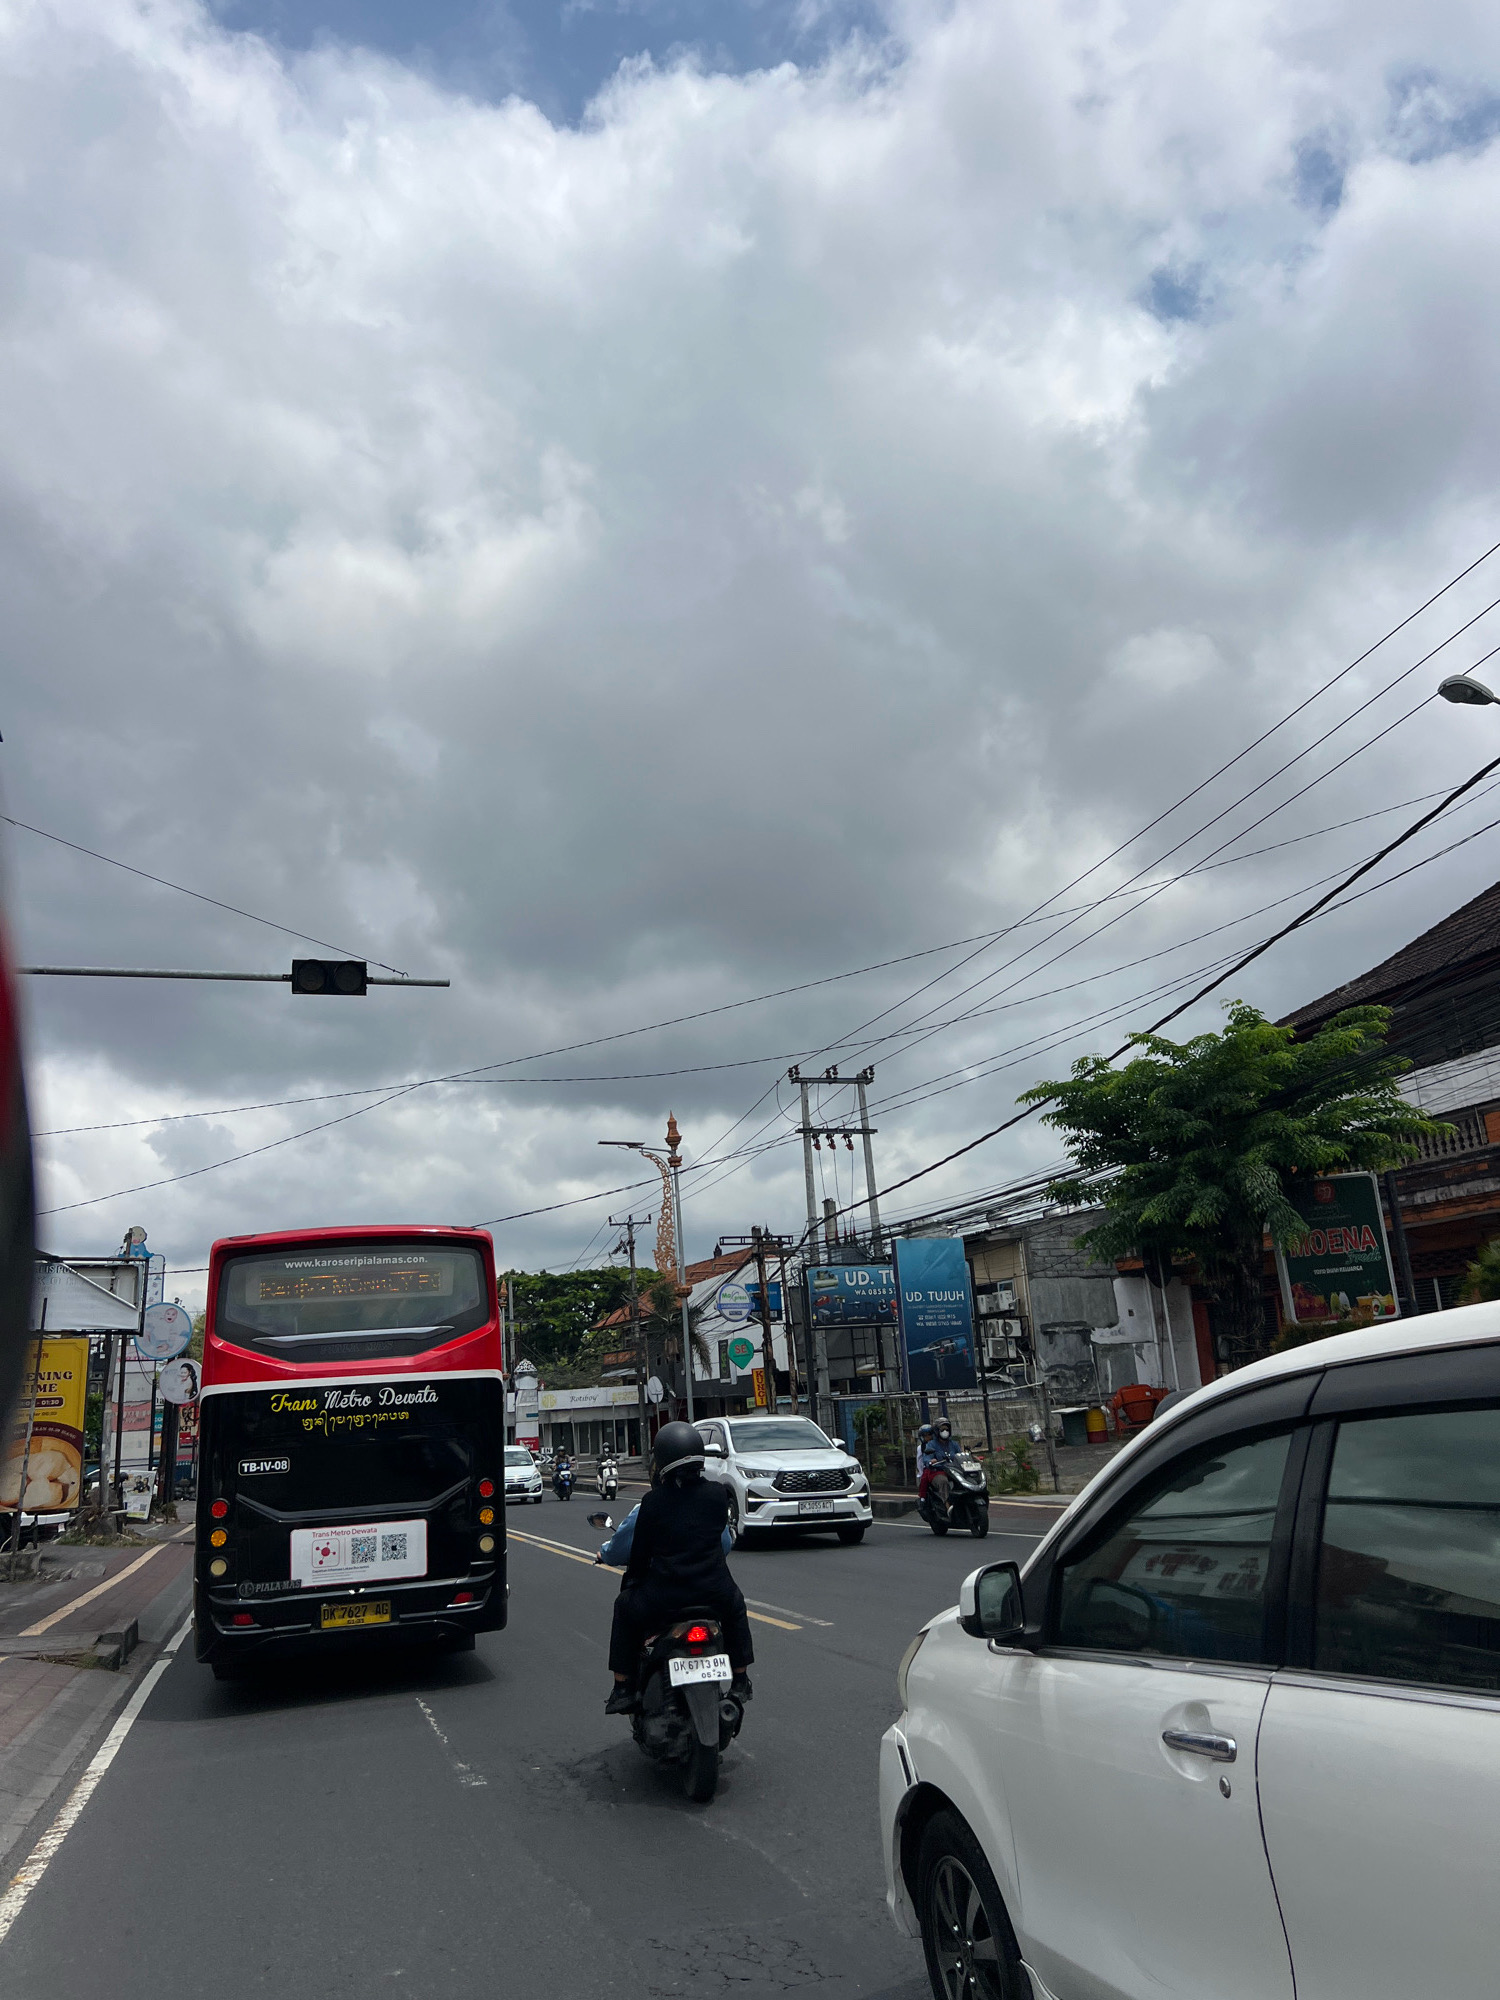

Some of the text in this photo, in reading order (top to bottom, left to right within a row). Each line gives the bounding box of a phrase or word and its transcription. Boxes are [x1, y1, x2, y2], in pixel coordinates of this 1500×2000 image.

[1290, 1224, 1378, 1258] MOENA
[844, 1270, 874, 1286] UD.
[868, 1288, 887, 1296] 0858
[905, 1290, 965, 1303] UD. TUJUH
[26, 1371, 73, 1381] ENING
[755, 1370, 765, 1404] KUNCI
[270, 1385, 439, 1412] Trans Metro Dewata
[241, 1460, 288, 1473] TB-IV-08
[312, 1527, 378, 1539] Trans Metro Dewata
[255, 1579, 302, 1593] PIALA MAS
[322, 1602, 389, 1621] DK 7627 AG
[673, 1661, 686, 1672] DK
[688, 1659, 711, 1670] 6713
